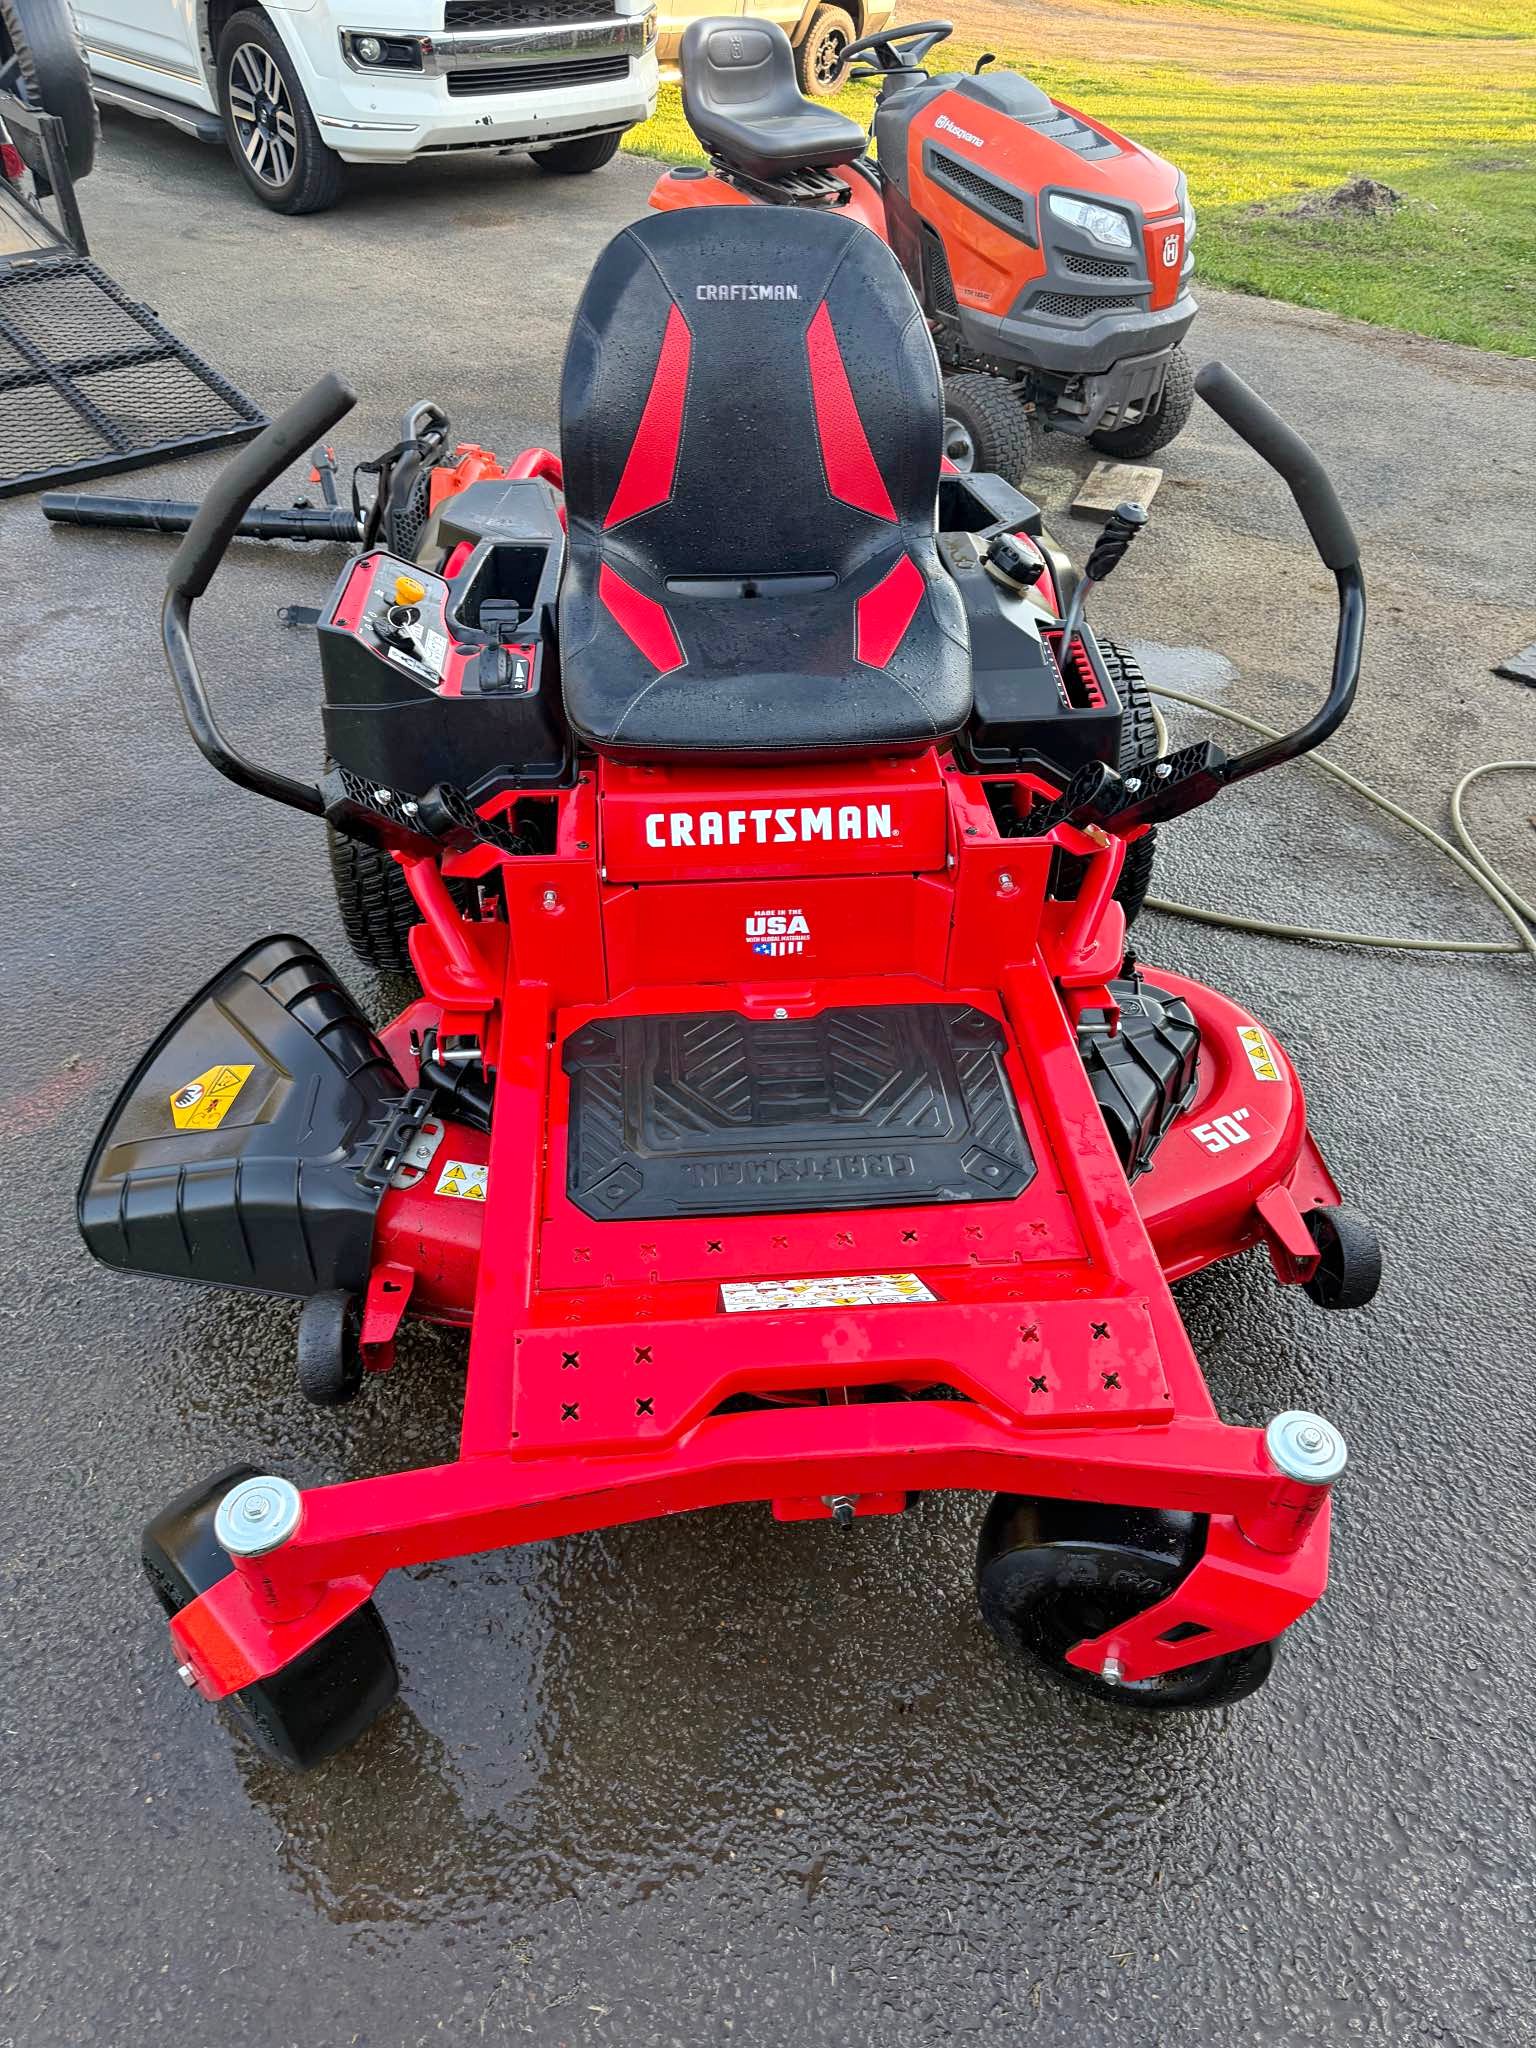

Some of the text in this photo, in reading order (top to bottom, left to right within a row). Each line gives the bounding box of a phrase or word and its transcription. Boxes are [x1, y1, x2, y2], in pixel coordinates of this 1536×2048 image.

[942, 119, 985, 148] Husqvarna
[696, 284, 799, 301] CRAFTSMAN
[645, 804, 892, 849] CRAFTSMAN
[746, 915, 810, 936] USA
[1190, 1107, 1250, 1153] 50"
[696, 1154, 917, 1187] CRAFTSMAN
